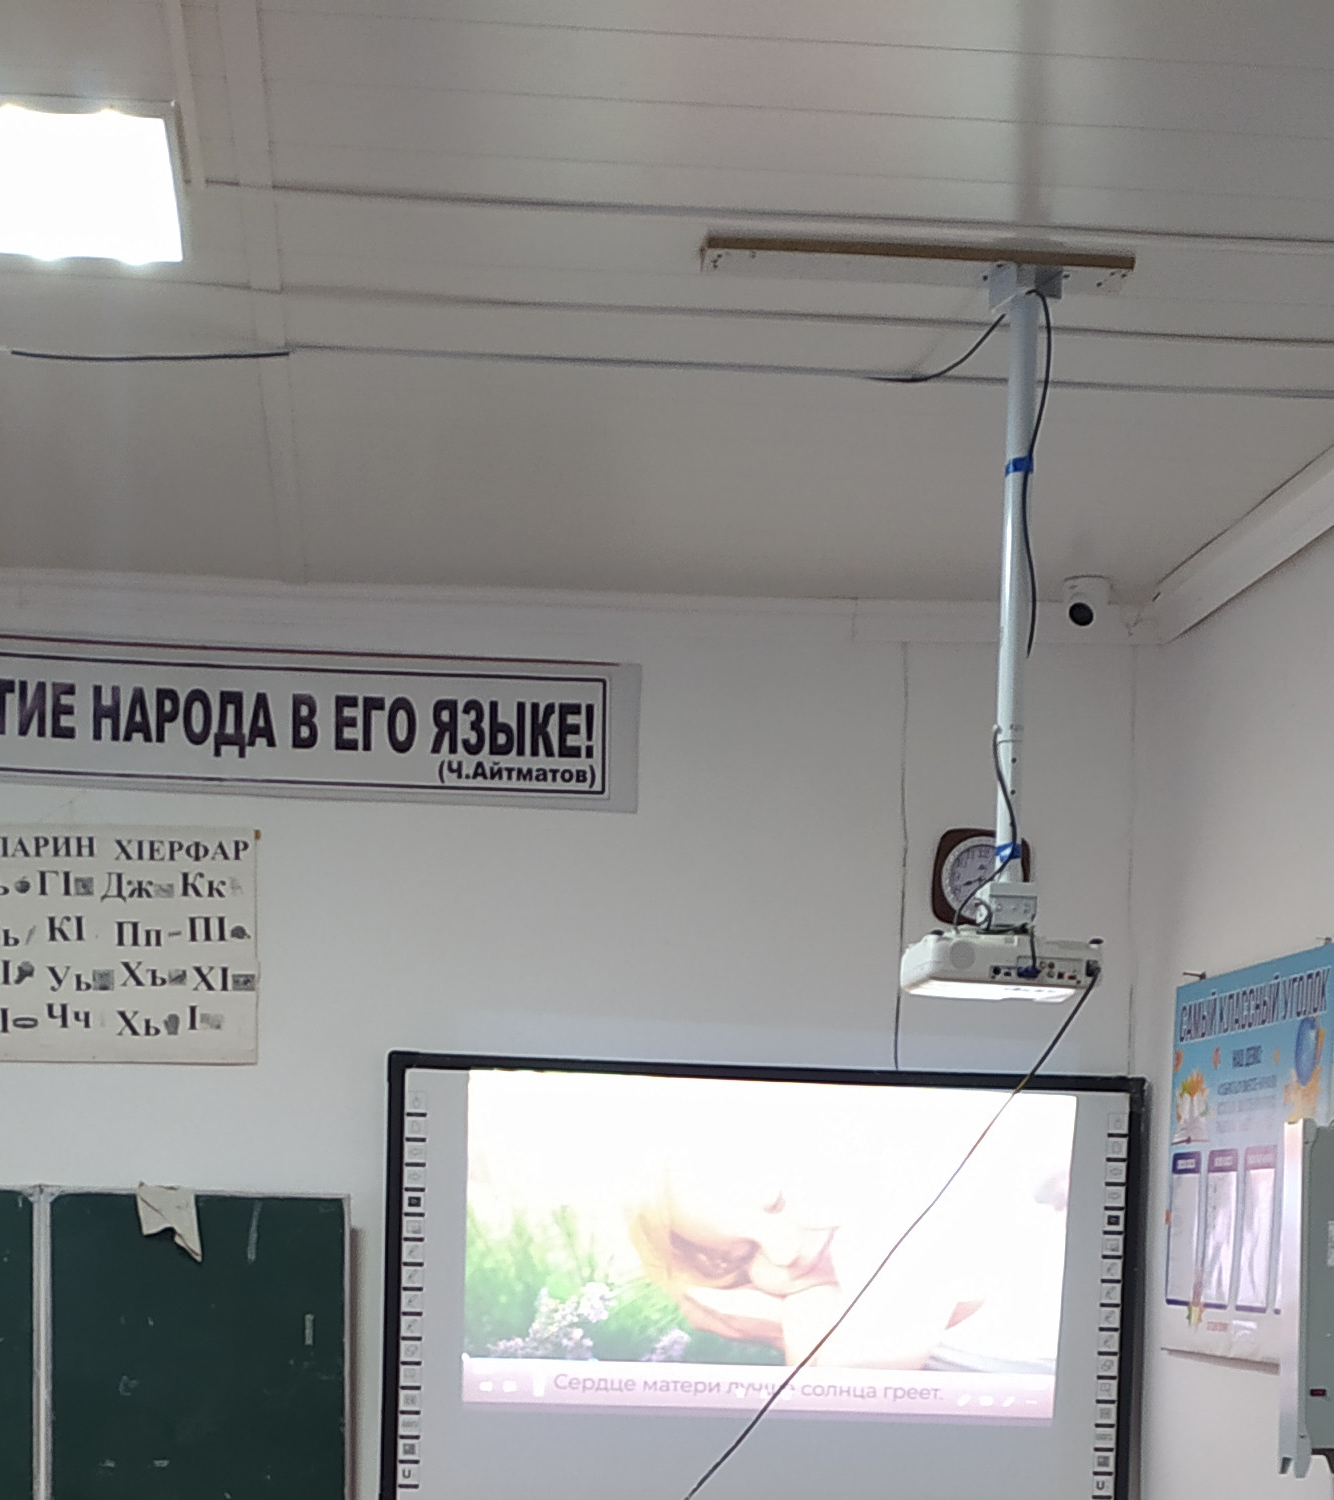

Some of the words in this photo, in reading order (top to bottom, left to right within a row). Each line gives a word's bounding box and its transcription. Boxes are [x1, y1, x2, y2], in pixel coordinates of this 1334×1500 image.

[92, 684, 275, 757] НАРОДА
[291, 694, 317, 750] В
[335, 696, 417, 753] ЕГО
[430, 699, 596, 759] ЯЗЫКЕ!
[437, 759, 596, 789] (Ч.Айтматов)
[101, 872, 153, 902] Дж
[180, 872, 226, 898] Кк
[116, 921, 162, 947] Пп
[46, 1003, 91, 1029] Чч
[553, 1374, 636, 1394] Сердце
[643, 1377, 721, 1396] матери
[801, 1382, 880, 1401] солнца
[883, 1385, 943, 1403] греет.
